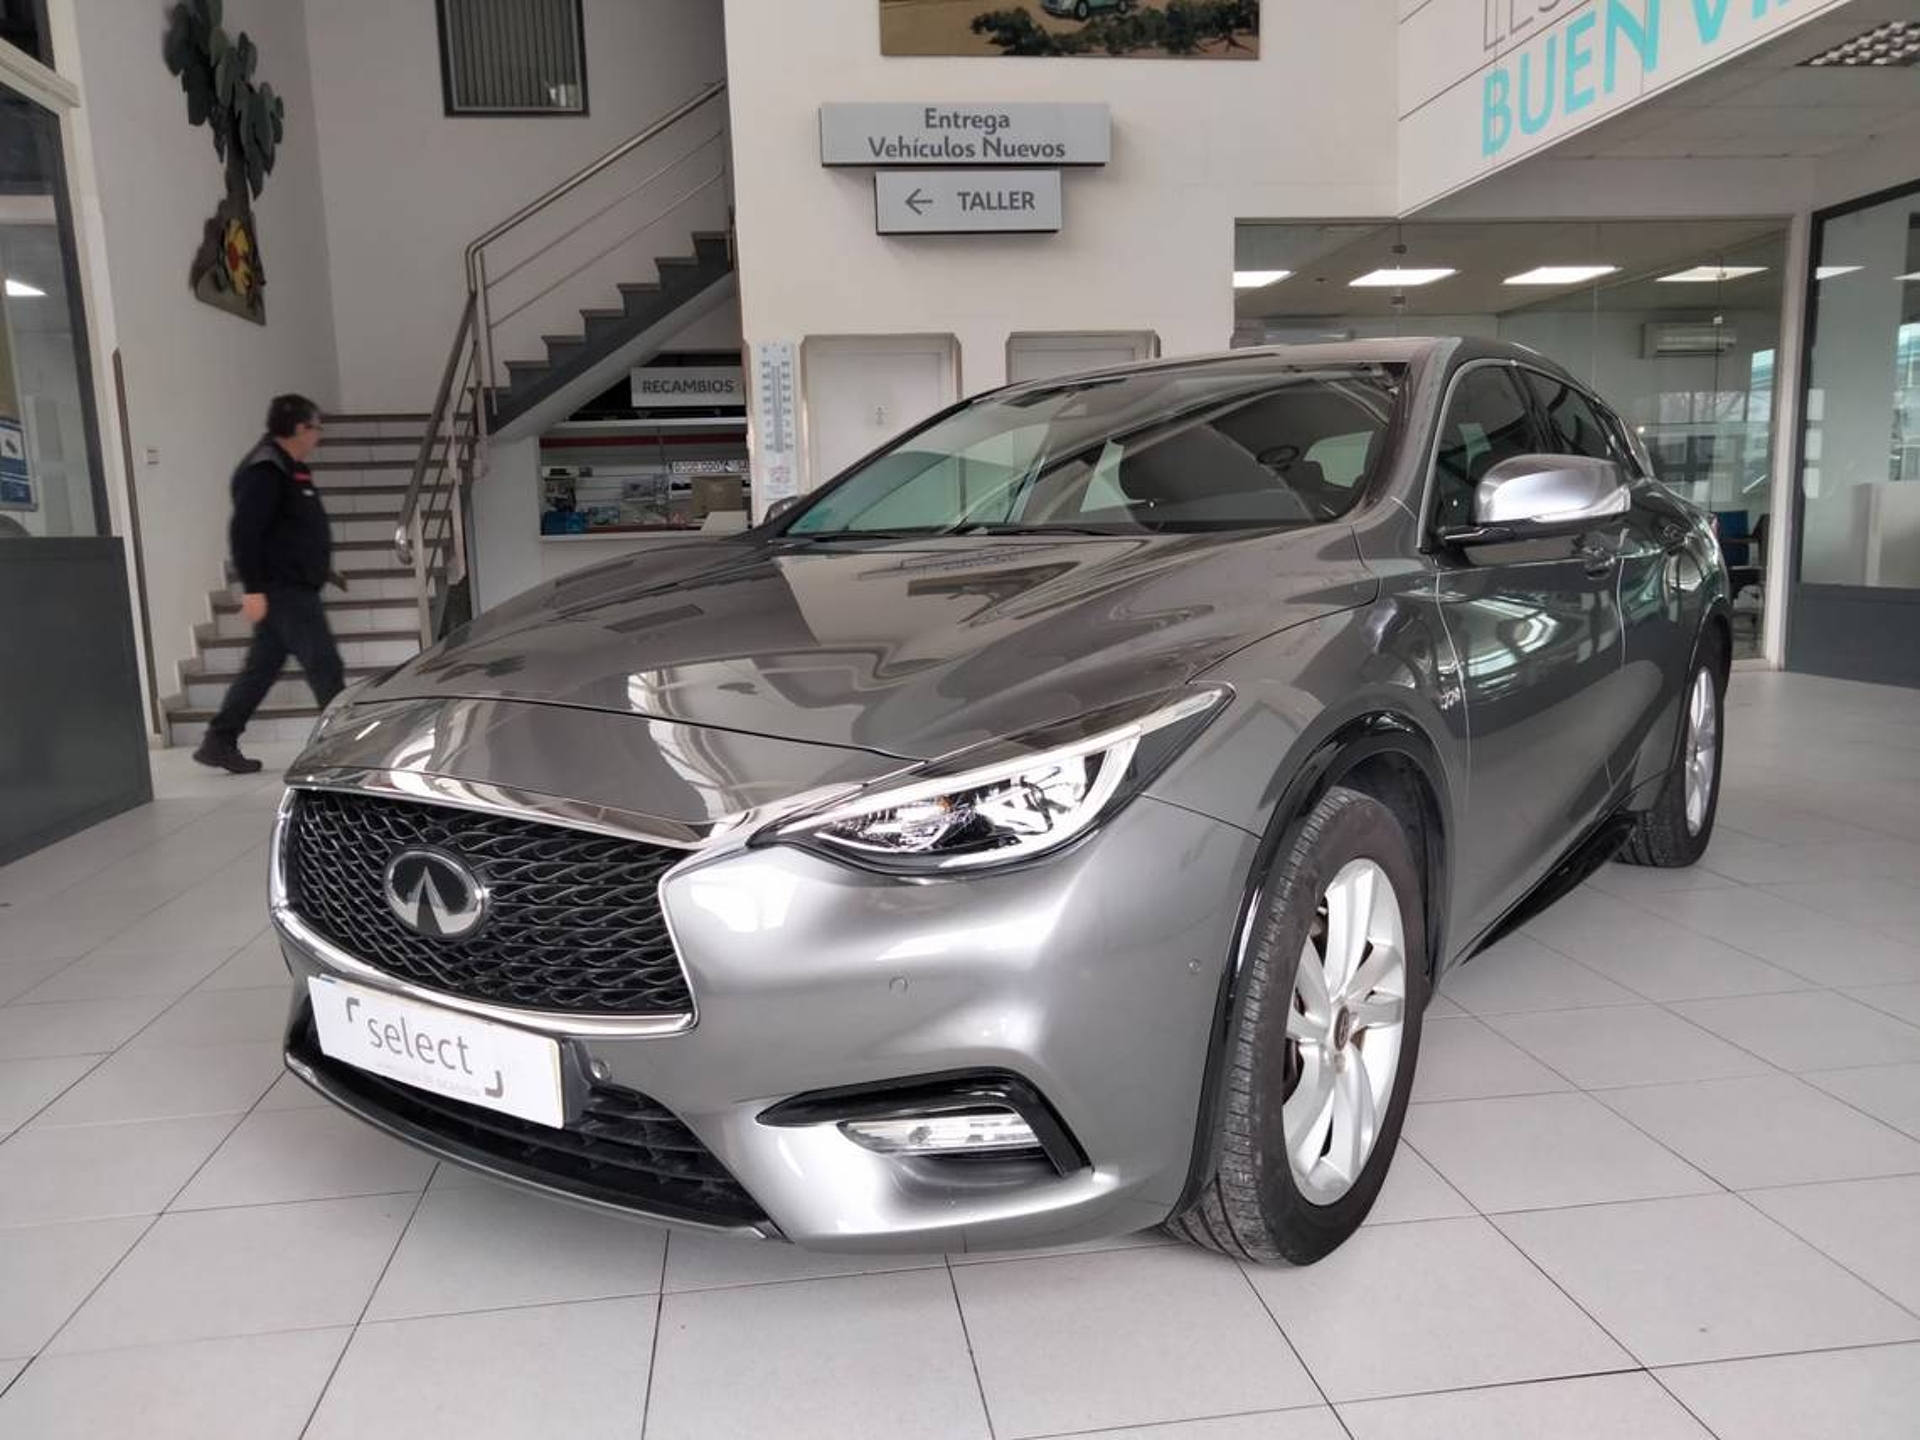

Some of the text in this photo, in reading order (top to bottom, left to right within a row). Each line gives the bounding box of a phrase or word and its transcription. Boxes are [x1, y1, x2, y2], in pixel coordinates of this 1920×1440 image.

[1481, 0, 1661, 158] BUEN
[924, 107, 1011, 134] Entrega
[867, 135, 1066, 159] Vehículos Nuevos
[956, 191, 1036, 212] TALLER
[642, 378, 735, 393] RECAMBIOS
[366, 1016, 473, 1075] select
